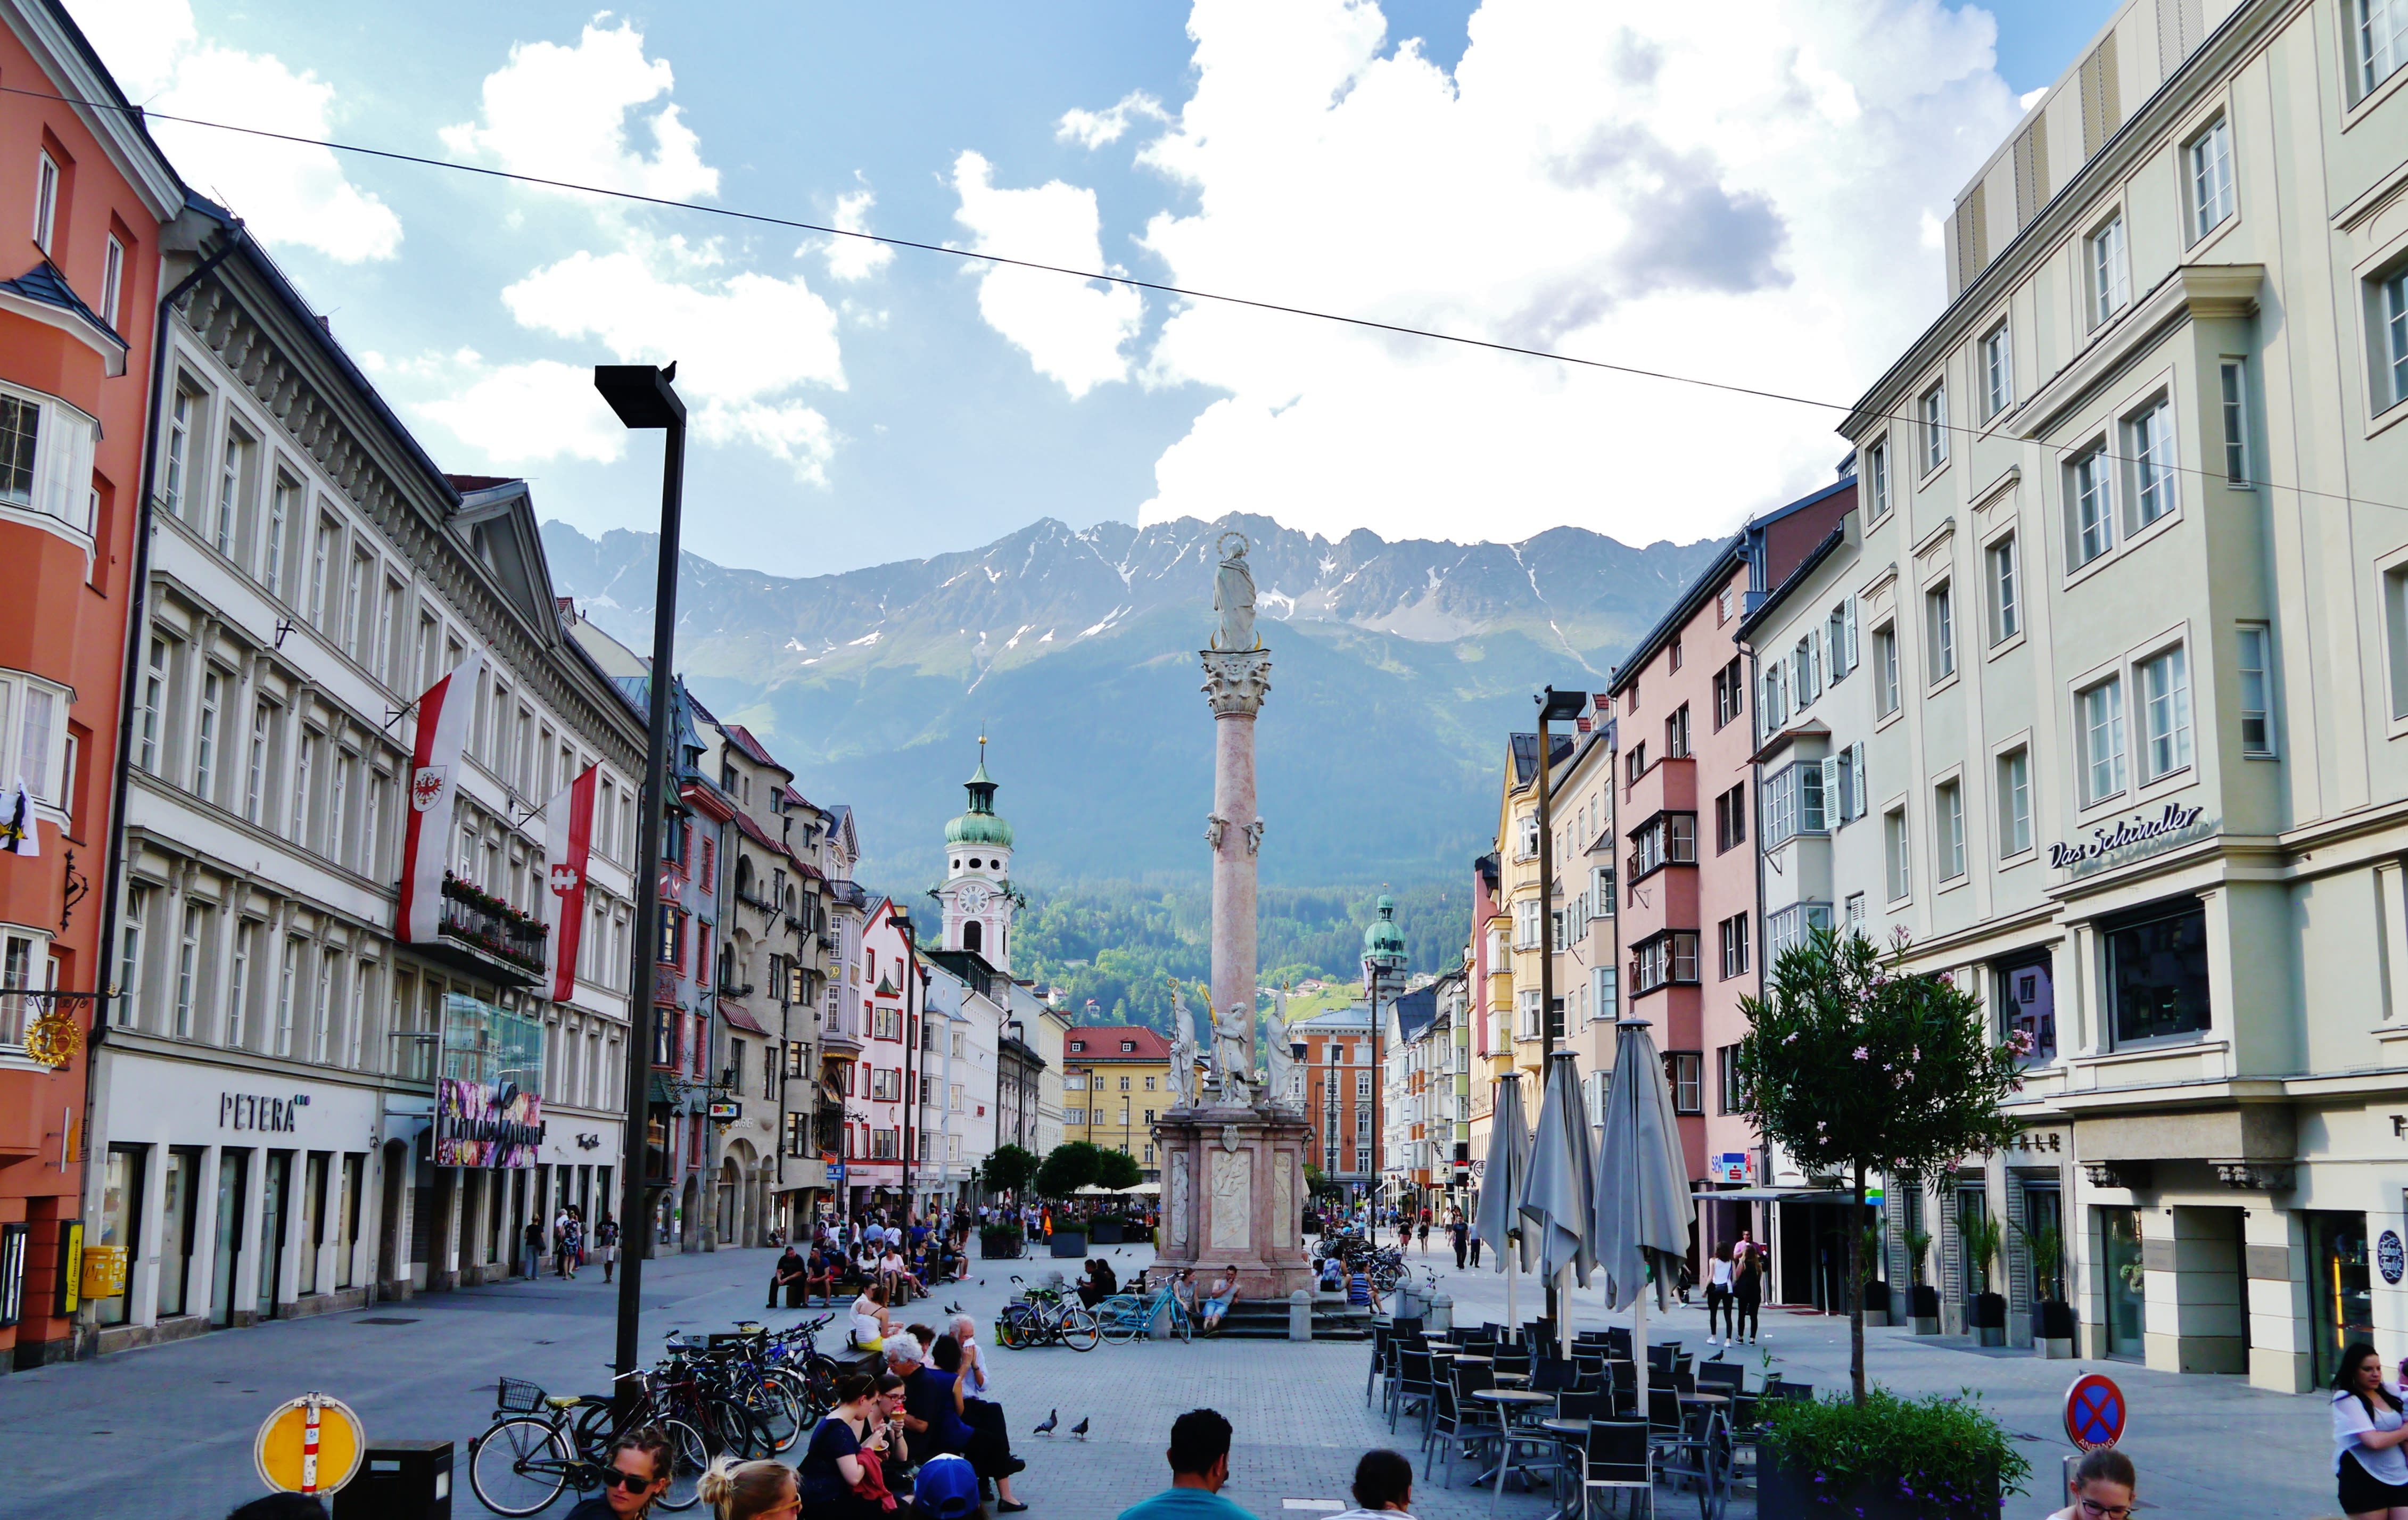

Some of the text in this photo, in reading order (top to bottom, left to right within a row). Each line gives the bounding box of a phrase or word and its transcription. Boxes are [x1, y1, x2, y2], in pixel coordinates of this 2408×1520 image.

[2047, 803, 2203, 869] Das Schindler
[219, 1092, 295, 1133] PETERA
[2378, 1242, 2402, 1257] Tabak
